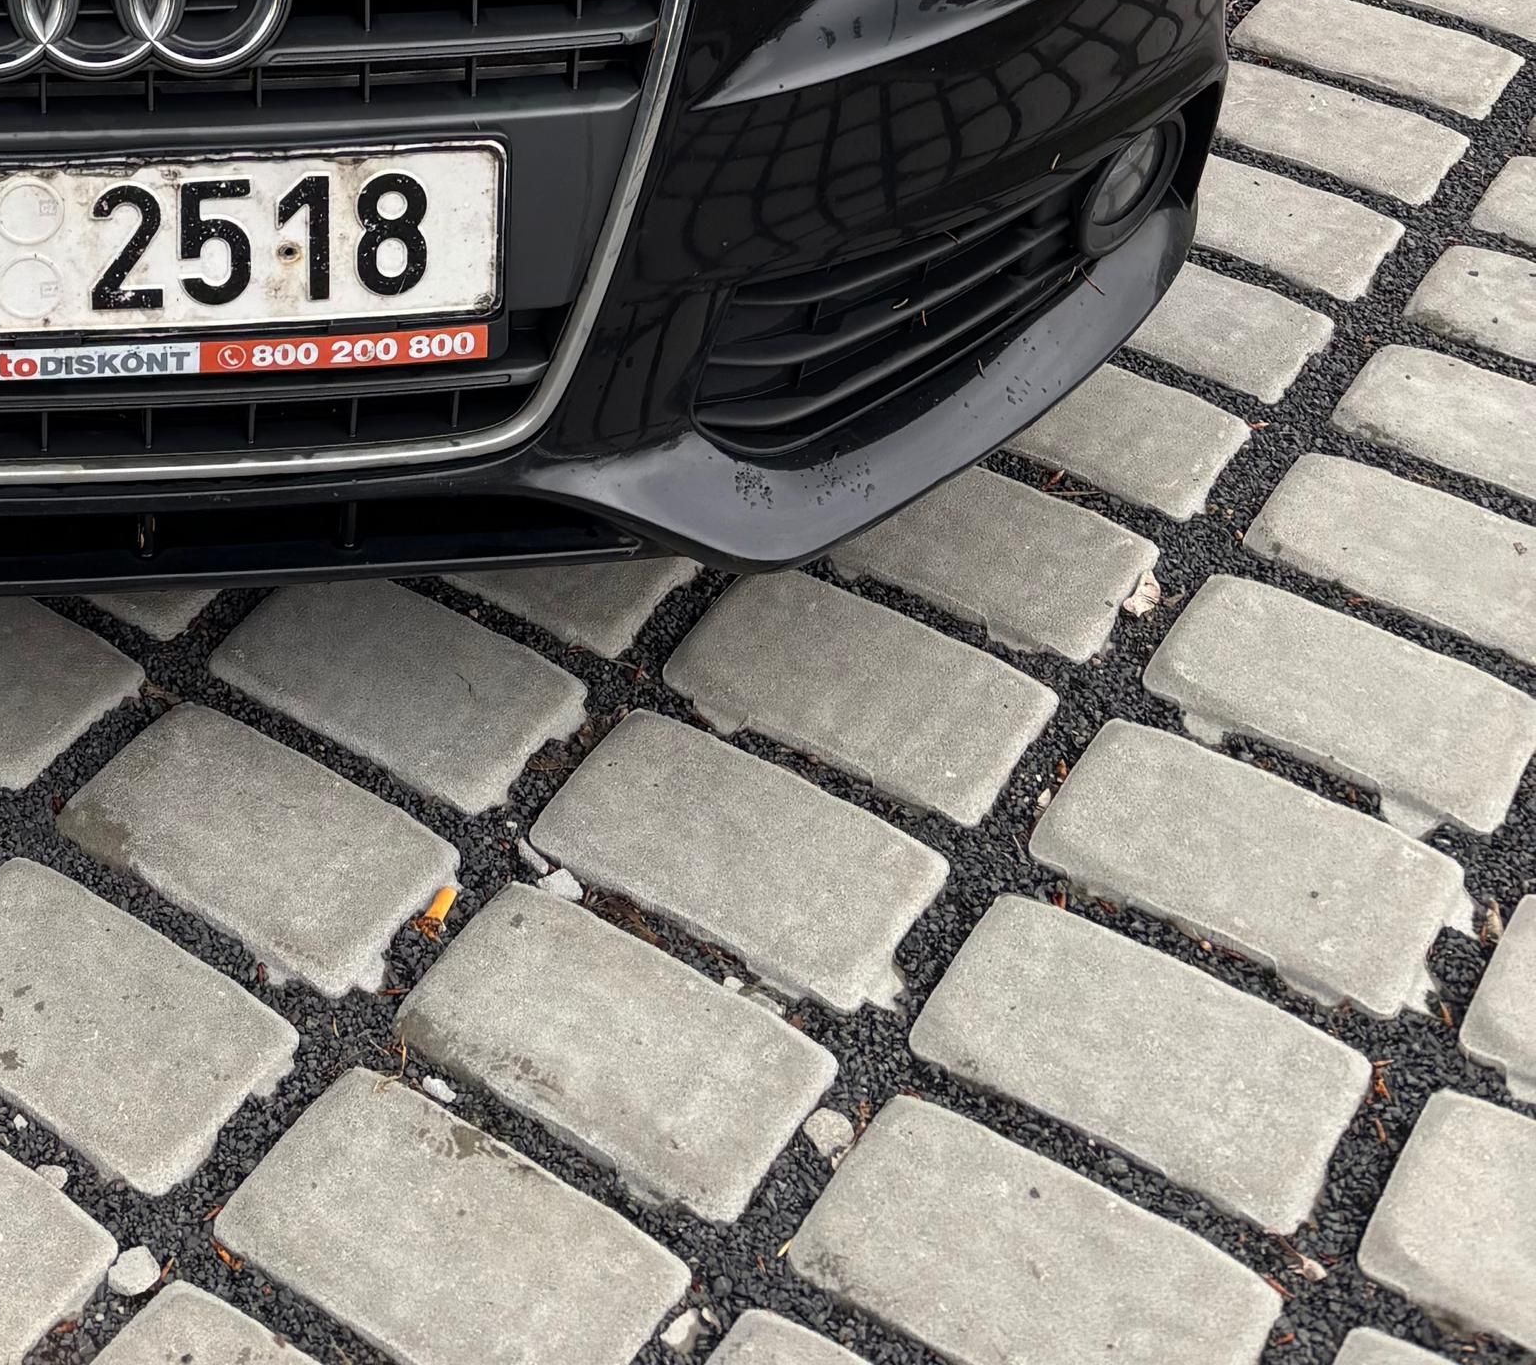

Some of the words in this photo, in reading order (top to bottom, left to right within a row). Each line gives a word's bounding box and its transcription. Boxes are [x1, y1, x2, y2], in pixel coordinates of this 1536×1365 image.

[91, 171, 428, 311] 2518
[252, 342, 319, 367] 800
[330, 337, 398, 364] 200
[408, 331, 475, 357] 800
